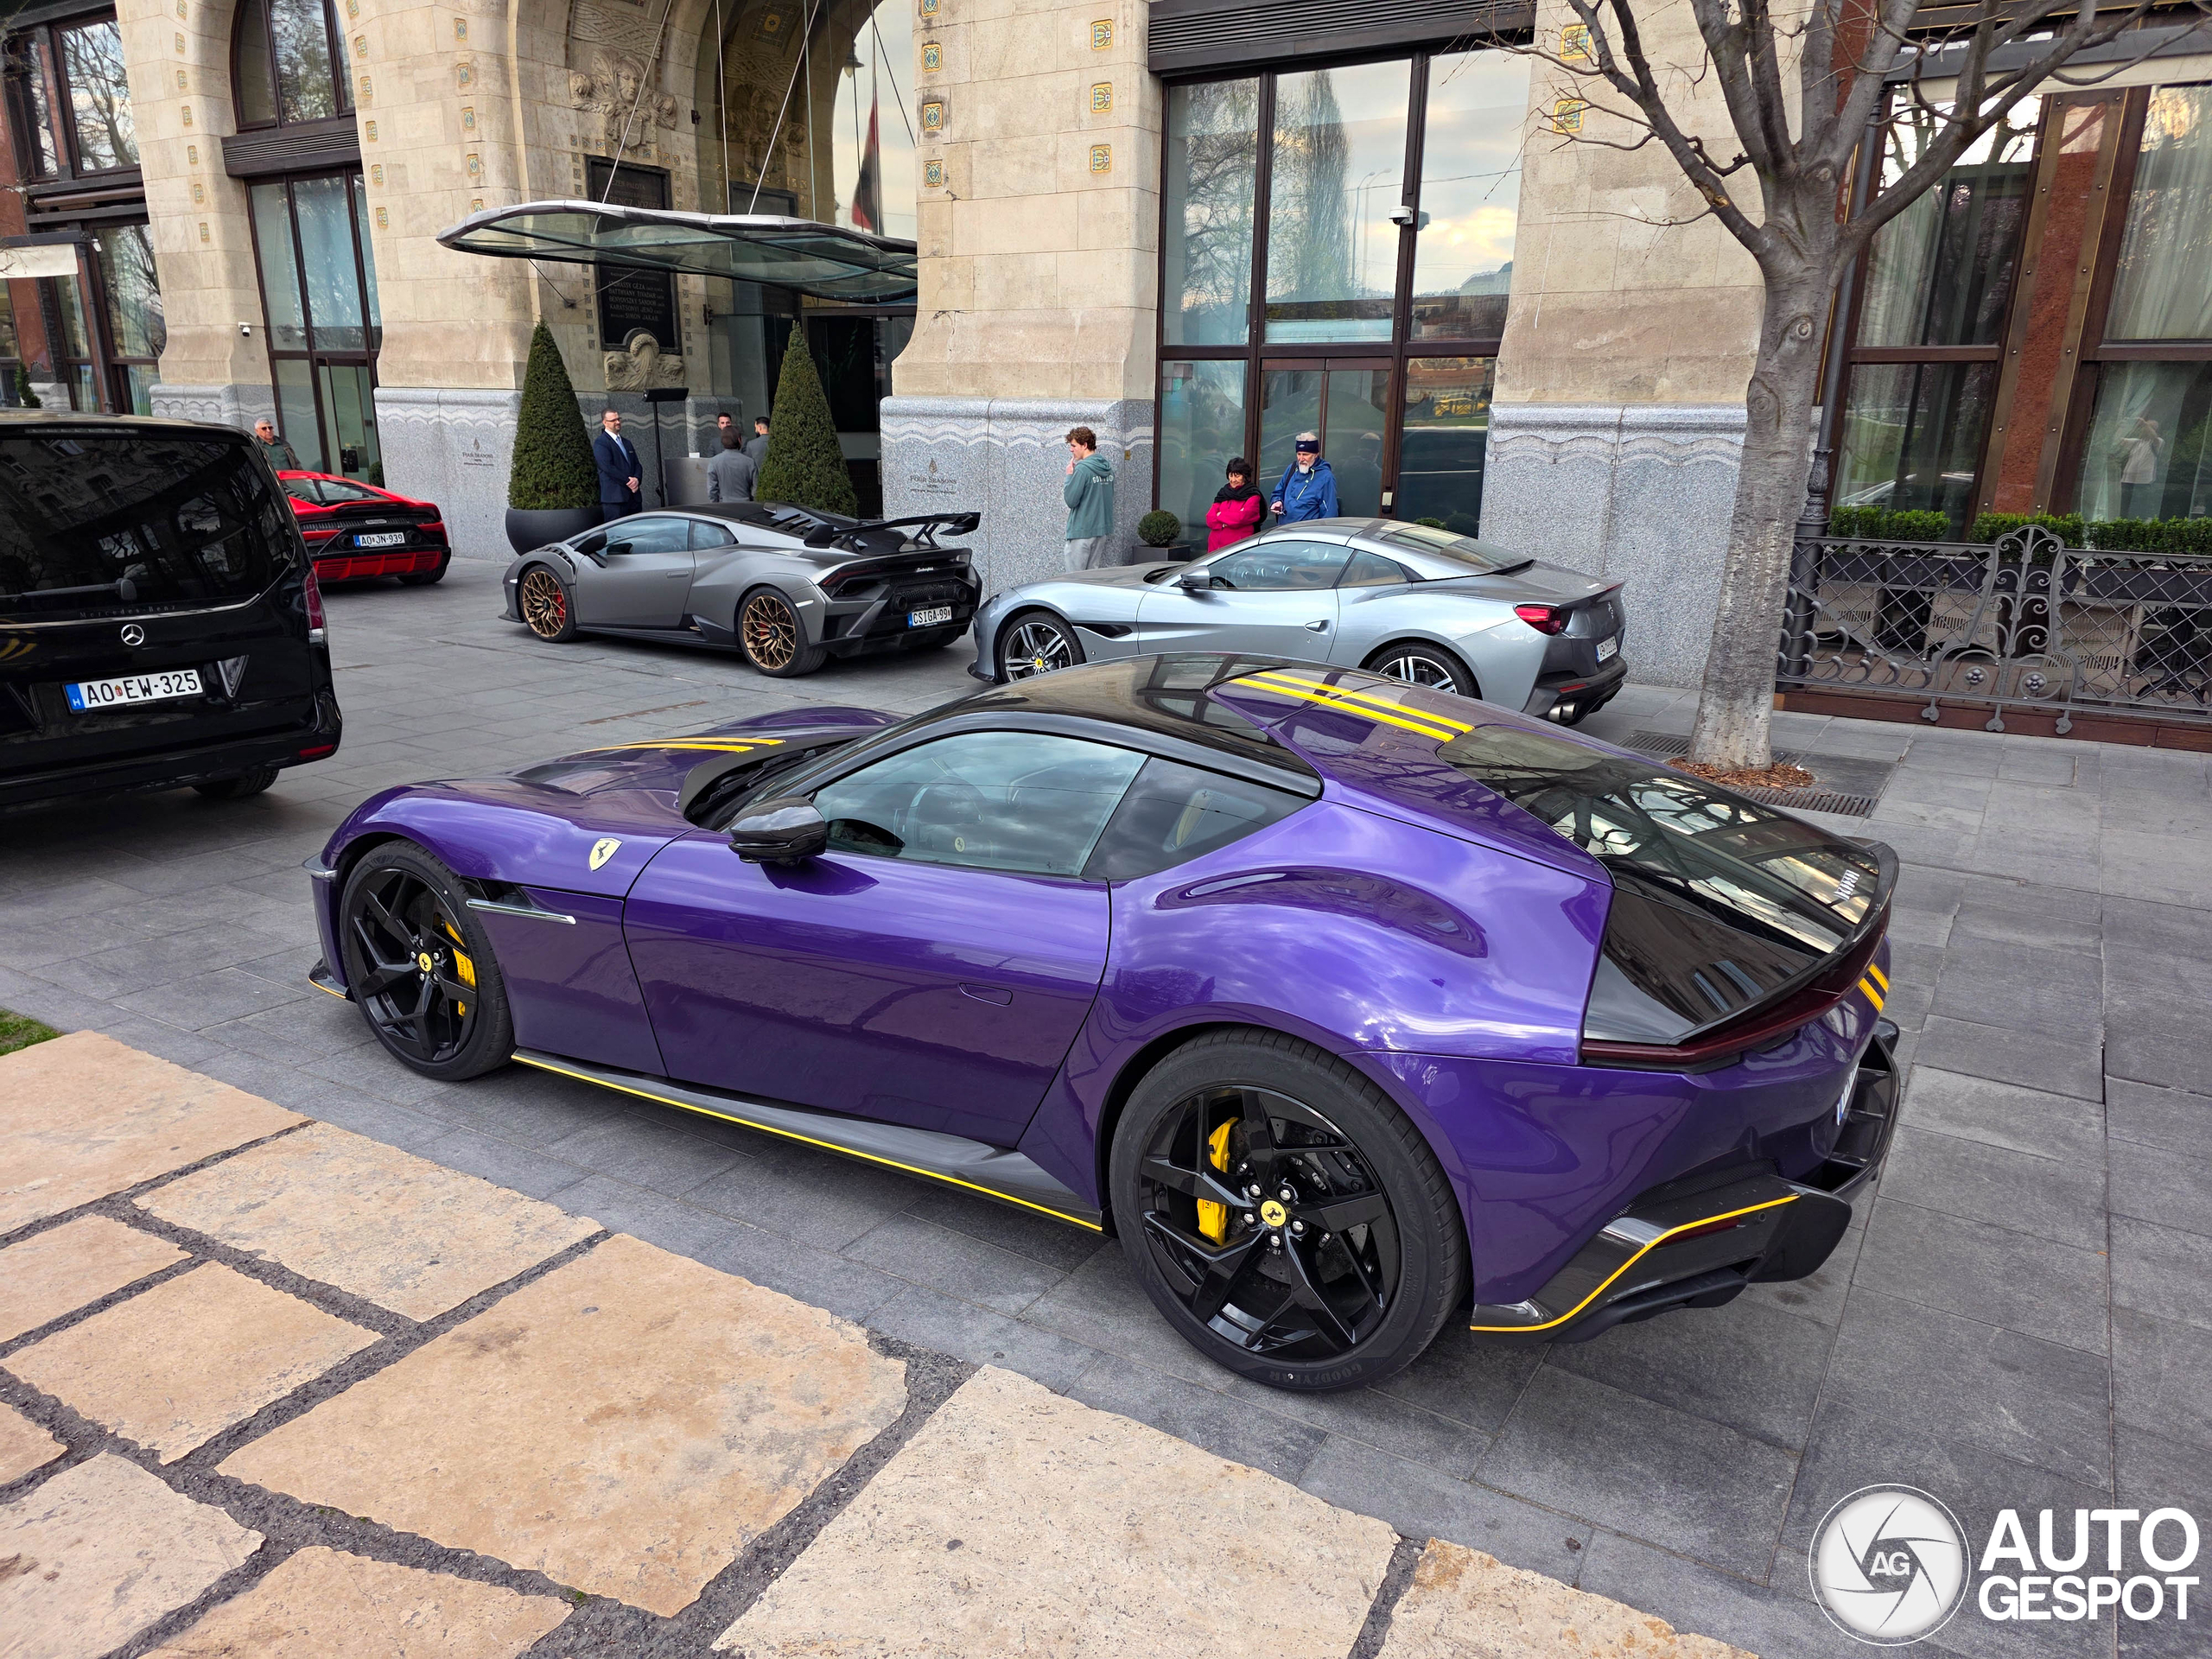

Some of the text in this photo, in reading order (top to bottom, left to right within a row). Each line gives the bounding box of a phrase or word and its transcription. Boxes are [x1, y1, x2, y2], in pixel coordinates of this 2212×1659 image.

[79, 605, 175, 618] Mercedes-Benz
[912, 607, 948, 624] CSIGA-99
[73, 698, 81, 707] H
